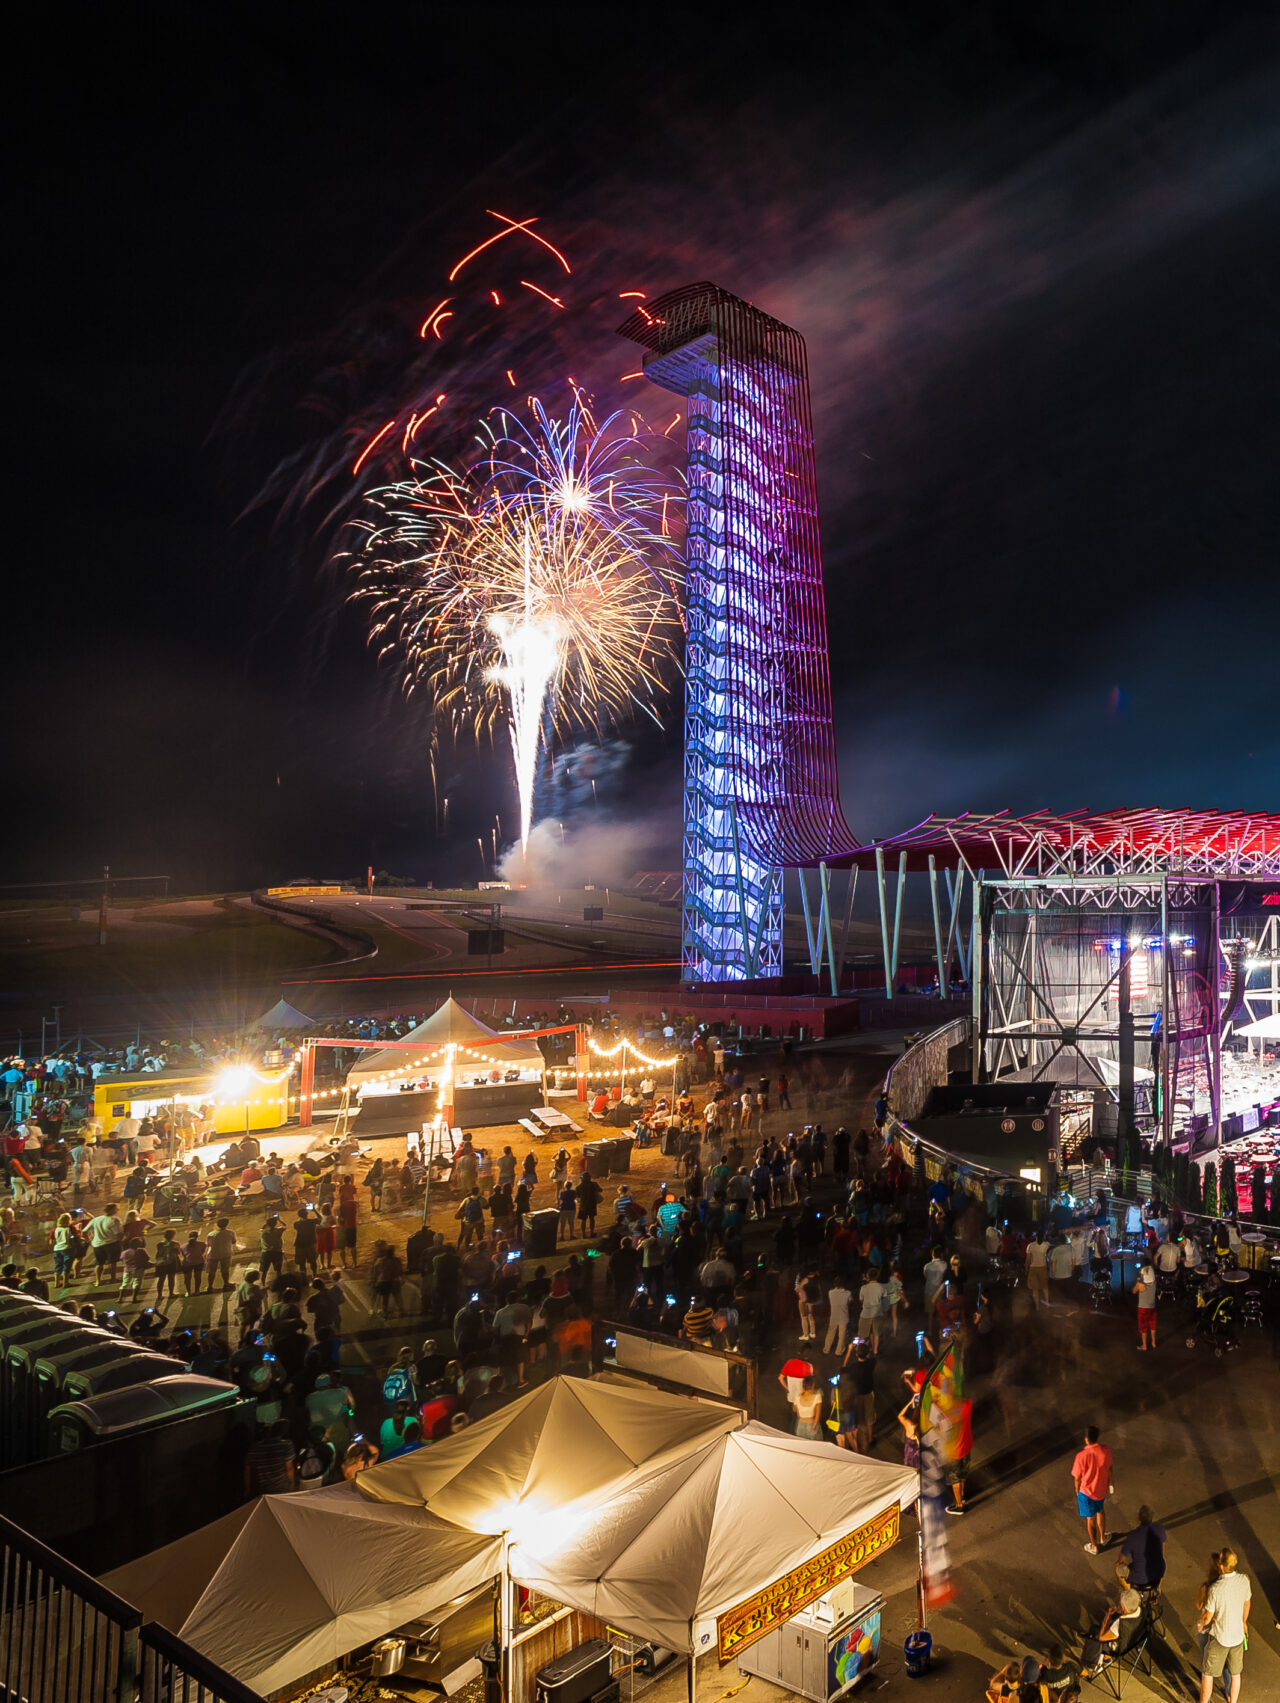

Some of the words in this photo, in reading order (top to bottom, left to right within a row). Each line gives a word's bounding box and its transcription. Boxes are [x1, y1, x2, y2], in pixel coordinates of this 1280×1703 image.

[722, 1567, 832, 1652] KETTLE
[833, 1518, 897, 1579] KORN
[757, 1579, 791, 1607] OLD
[793, 1524, 875, 1588] FASHIONED
